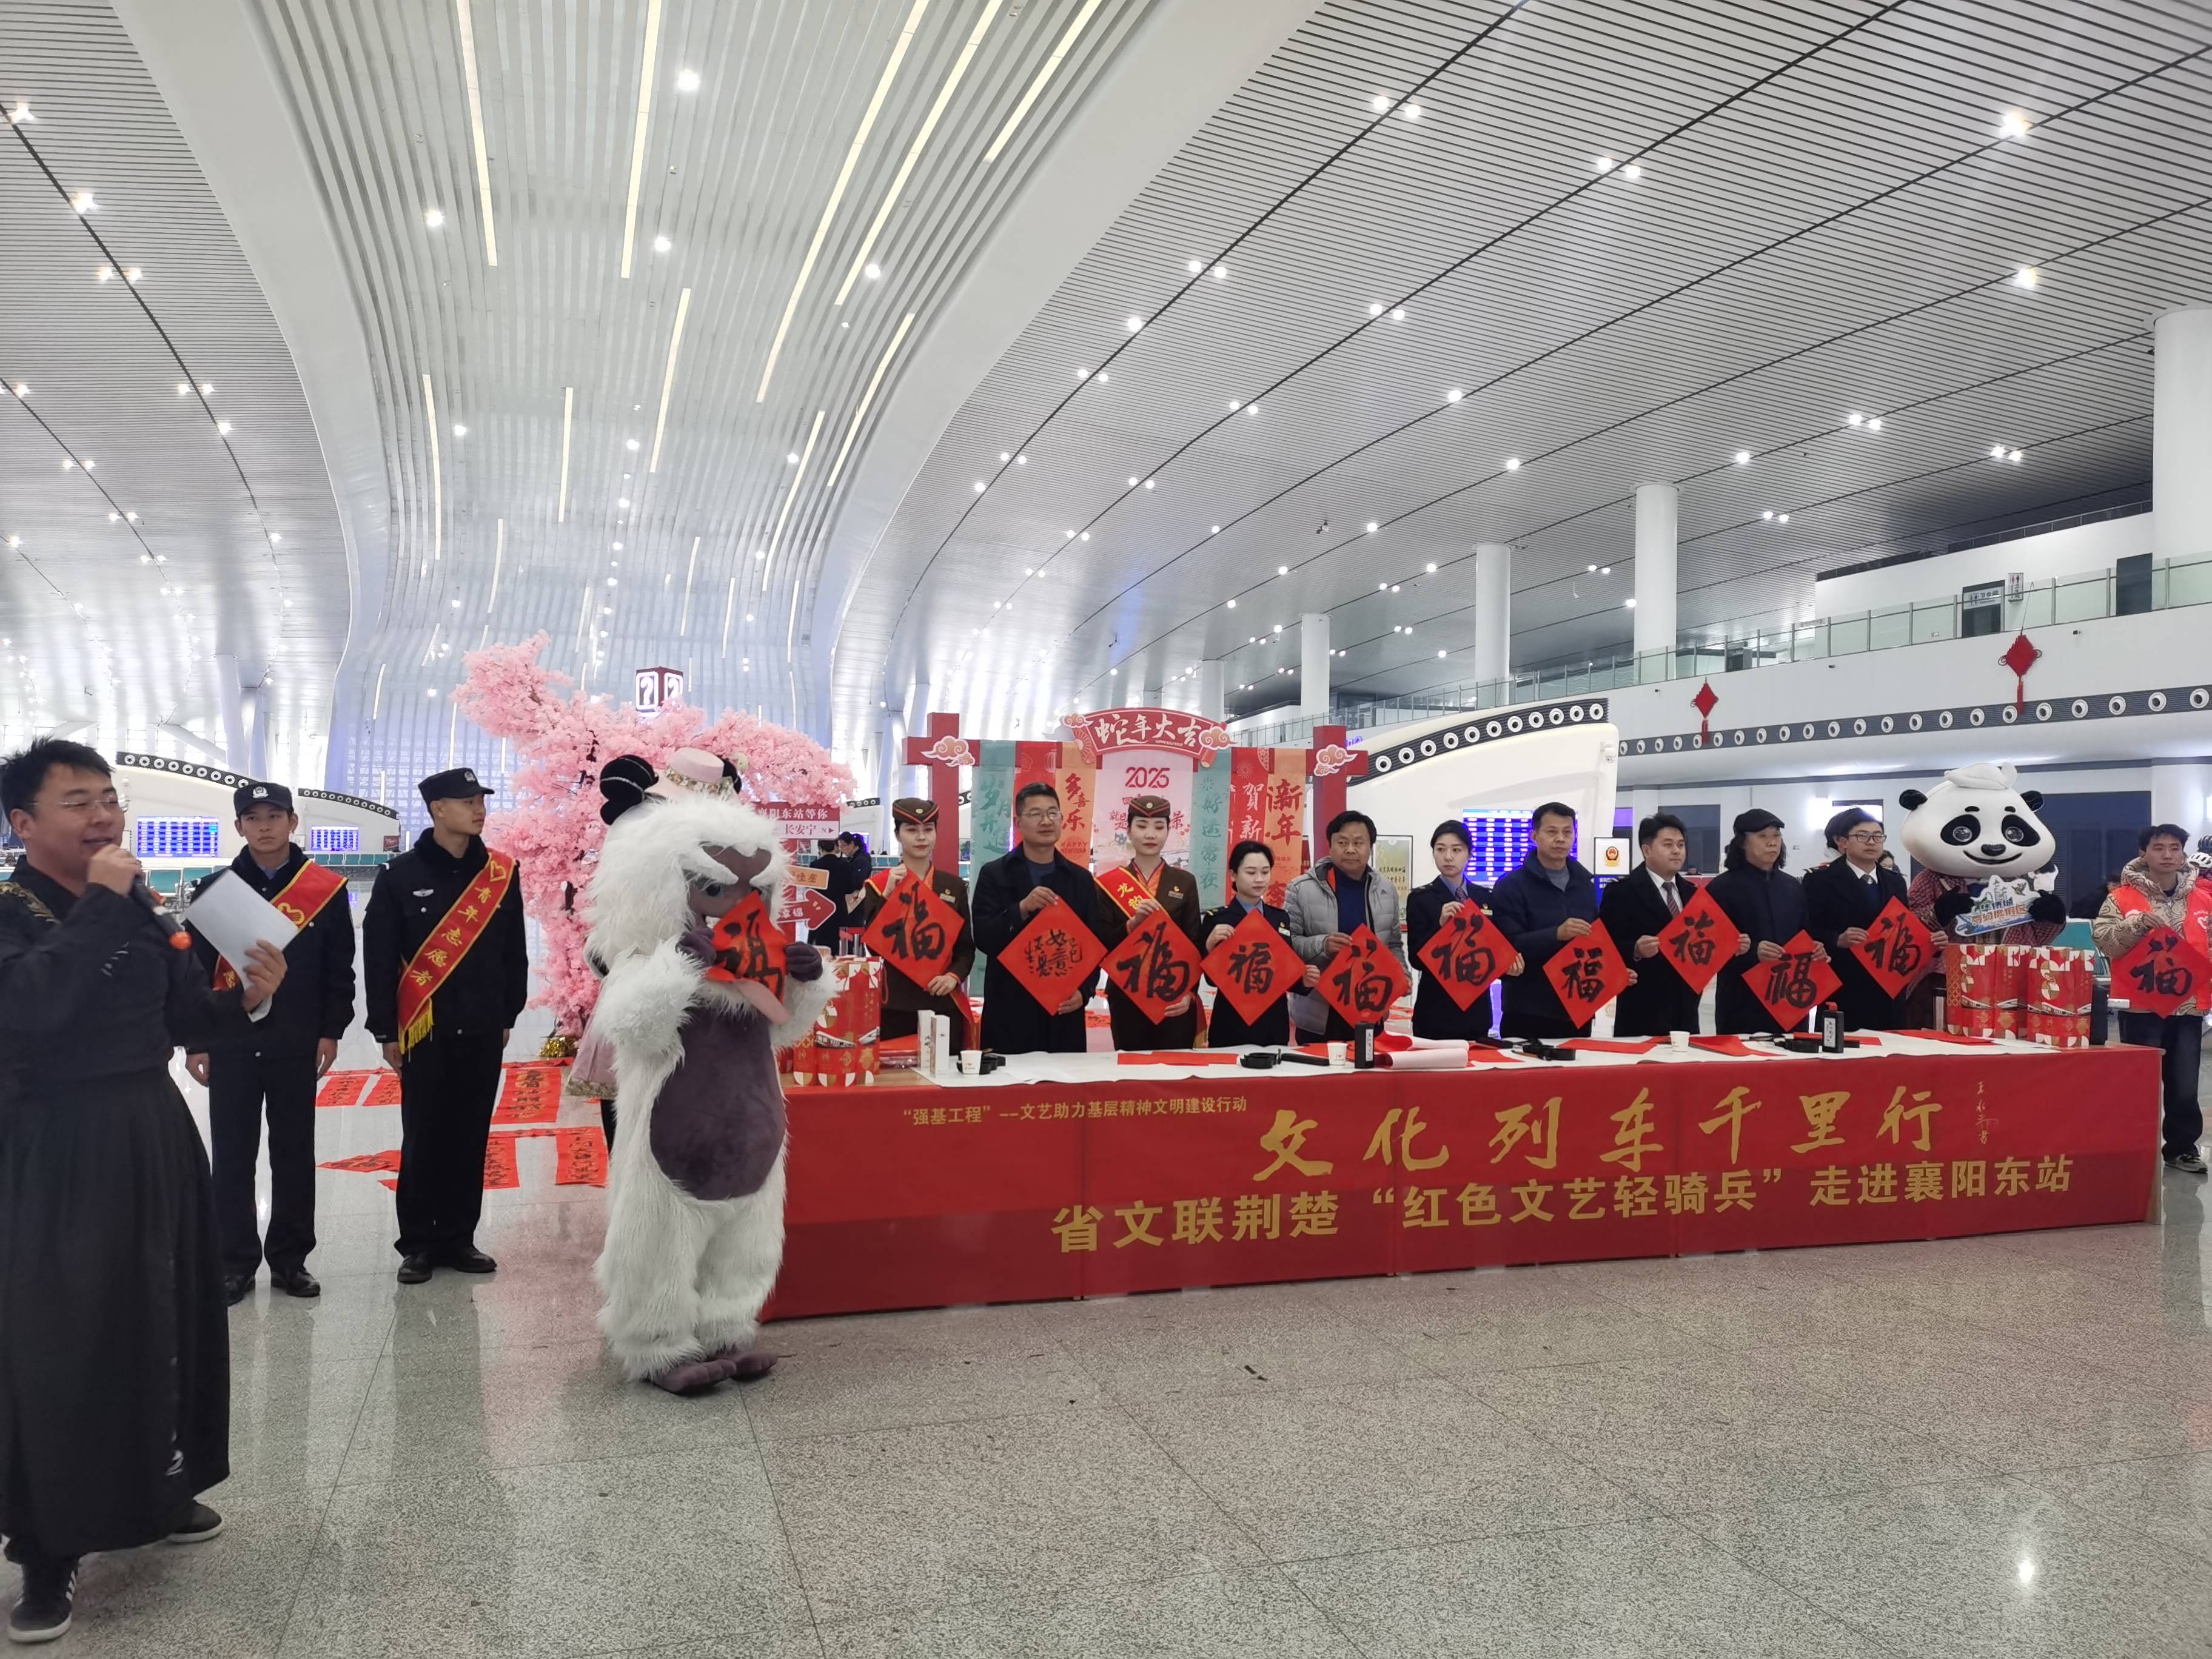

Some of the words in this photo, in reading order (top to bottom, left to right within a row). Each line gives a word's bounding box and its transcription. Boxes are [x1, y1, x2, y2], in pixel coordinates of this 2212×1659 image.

[1094, 713, 1202, 748] 蛇年大吉
[1125, 766, 1170, 788] 2025
[785, 824, 817, 836] 长安宁
[409, 886, 492, 986] 青年志愿者
[882, 881, 945, 960] 福
[1431, 914, 1495, 985] 福
[1669, 910, 1715, 965] 福
[1864, 912, 1922, 976] 福
[1116, 921, 1189, 1002] 福
[1228, 942, 1273, 996] 福
[1333, 939, 1393, 1012] 福
[1561, 947, 1605, 1002] 福
[1765, 951, 1817, 1008] 福
[2130, 934, 2192, 996] 福
[1253, 1085, 1943, 1182] 文化列车千里行
